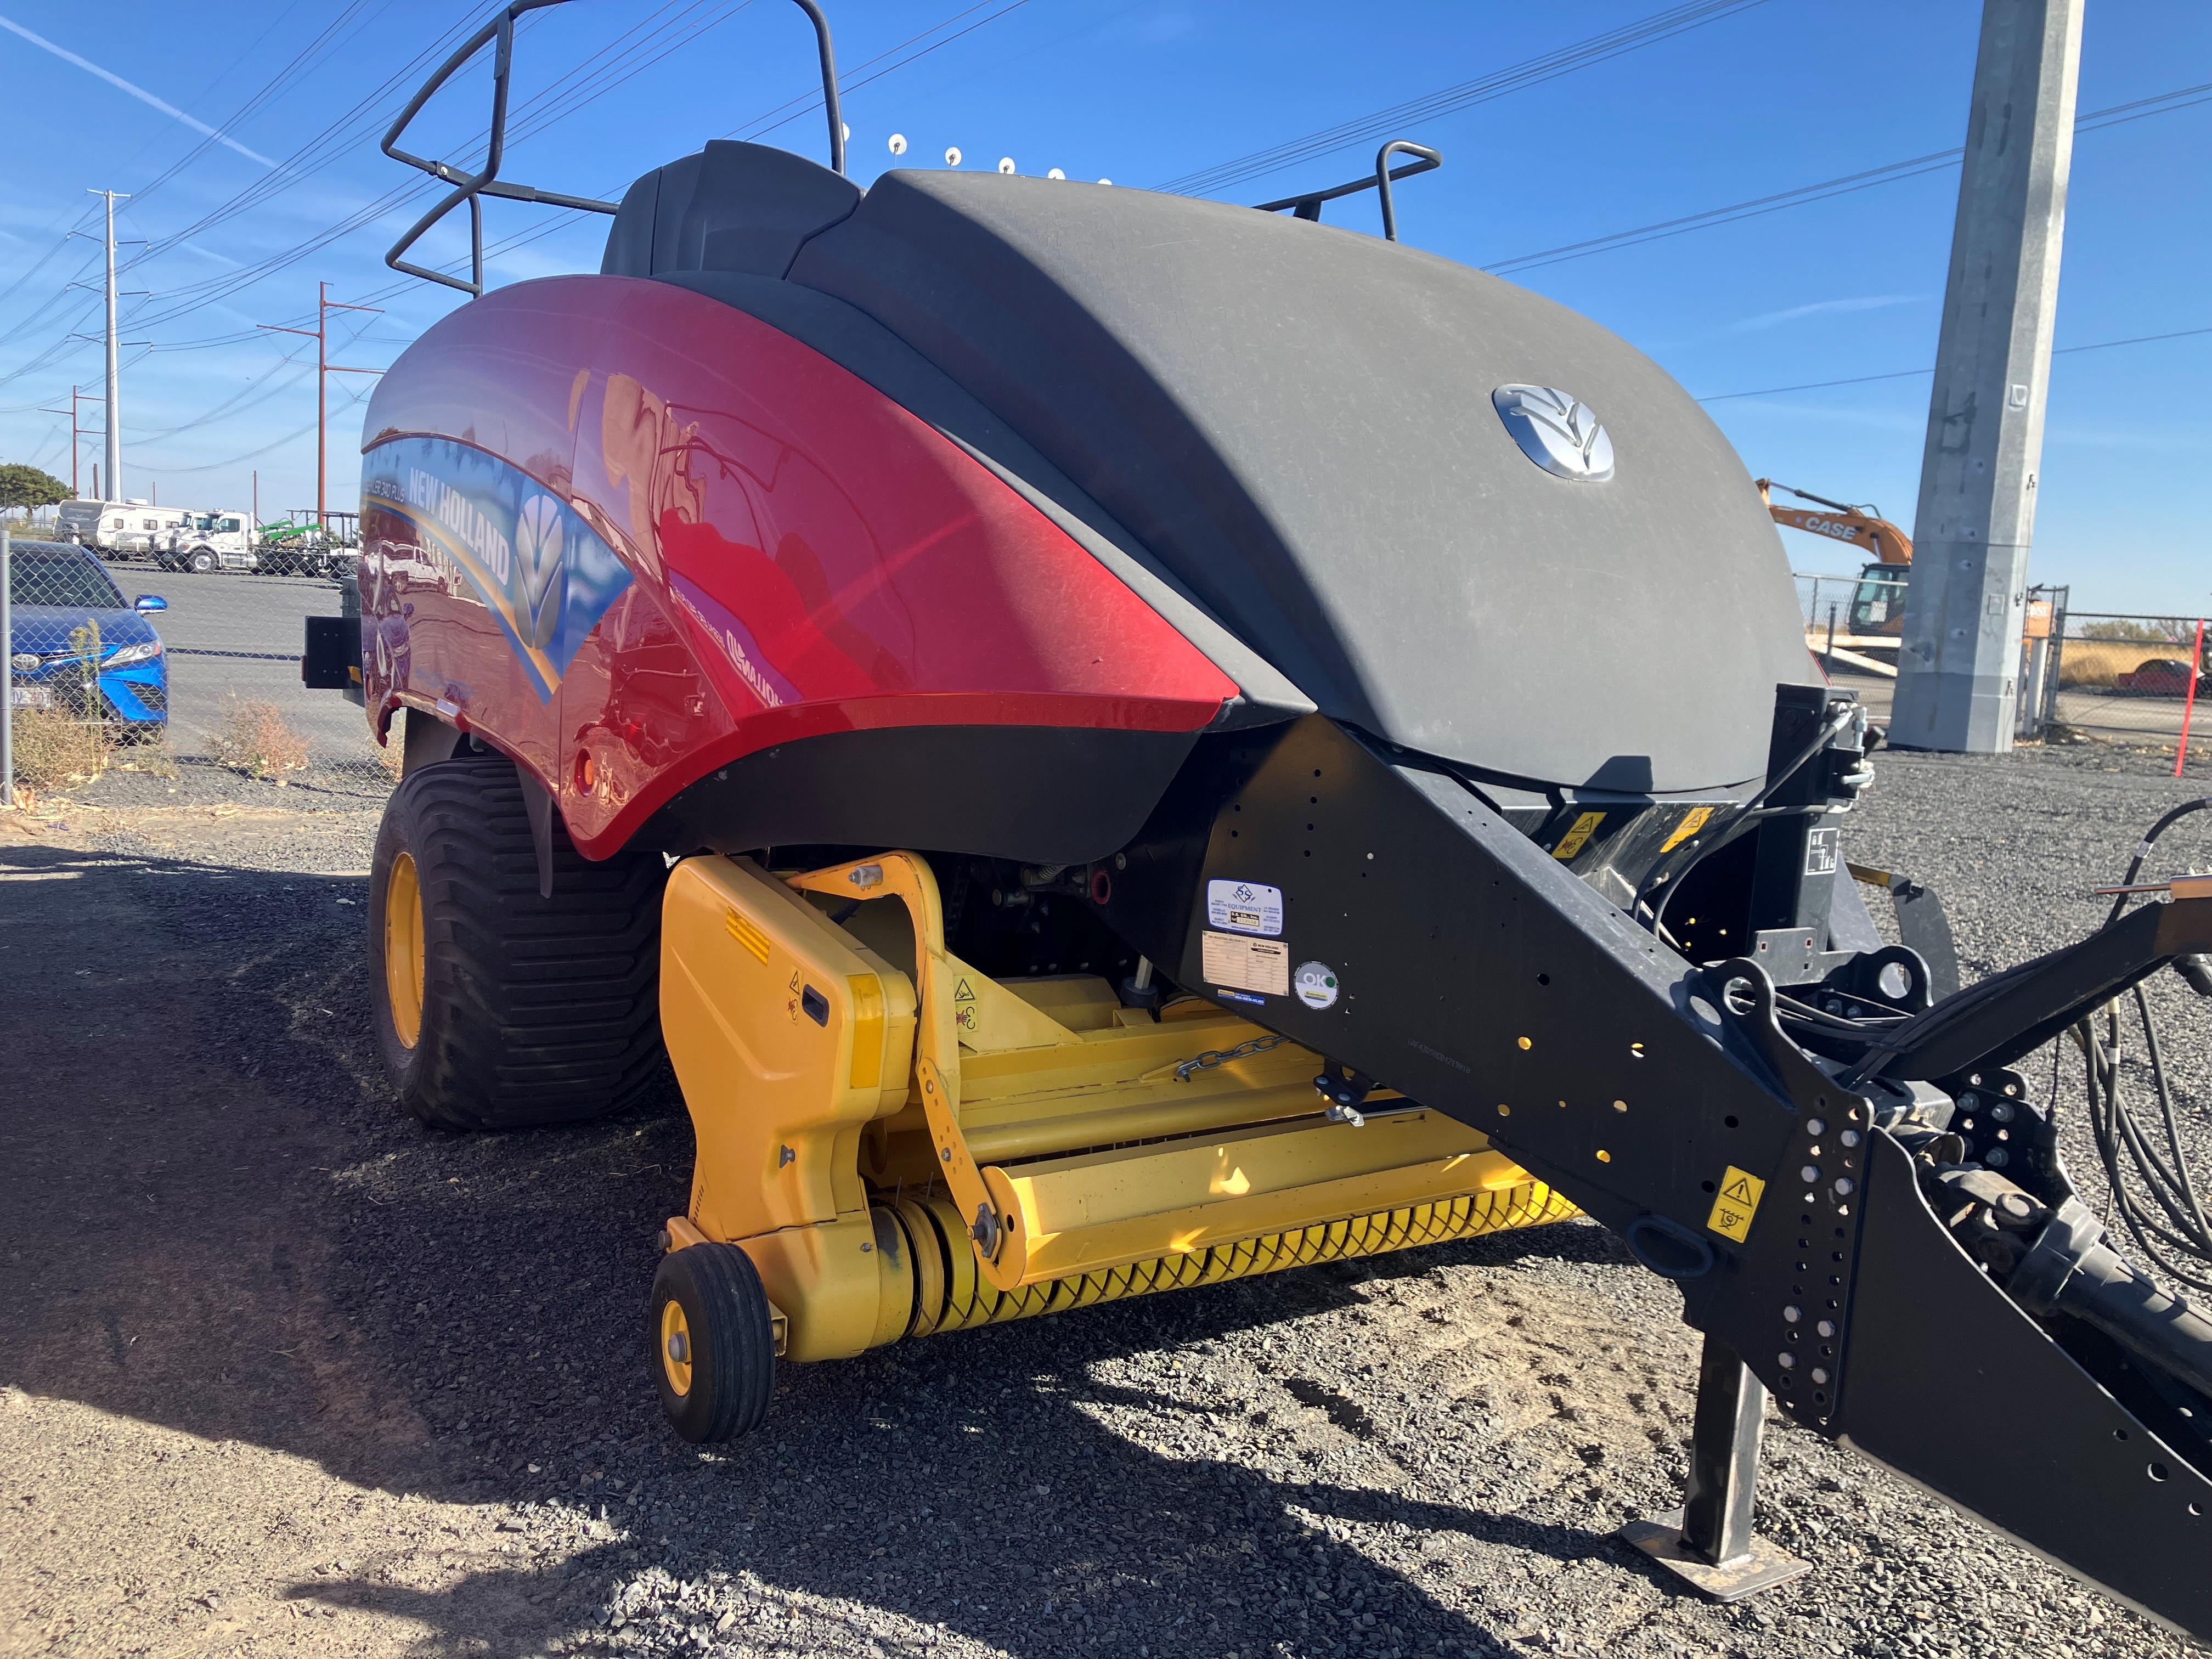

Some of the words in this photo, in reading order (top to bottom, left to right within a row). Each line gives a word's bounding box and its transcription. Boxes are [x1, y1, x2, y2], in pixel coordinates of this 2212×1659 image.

[409, 467, 438, 515] NEW
[439, 482, 510, 585] HOLLAND
[1805, 516, 1857, 540] CASE
[1228, 904, 1262, 912] EQUIPMENT
[1304, 973, 1329, 988] OK
